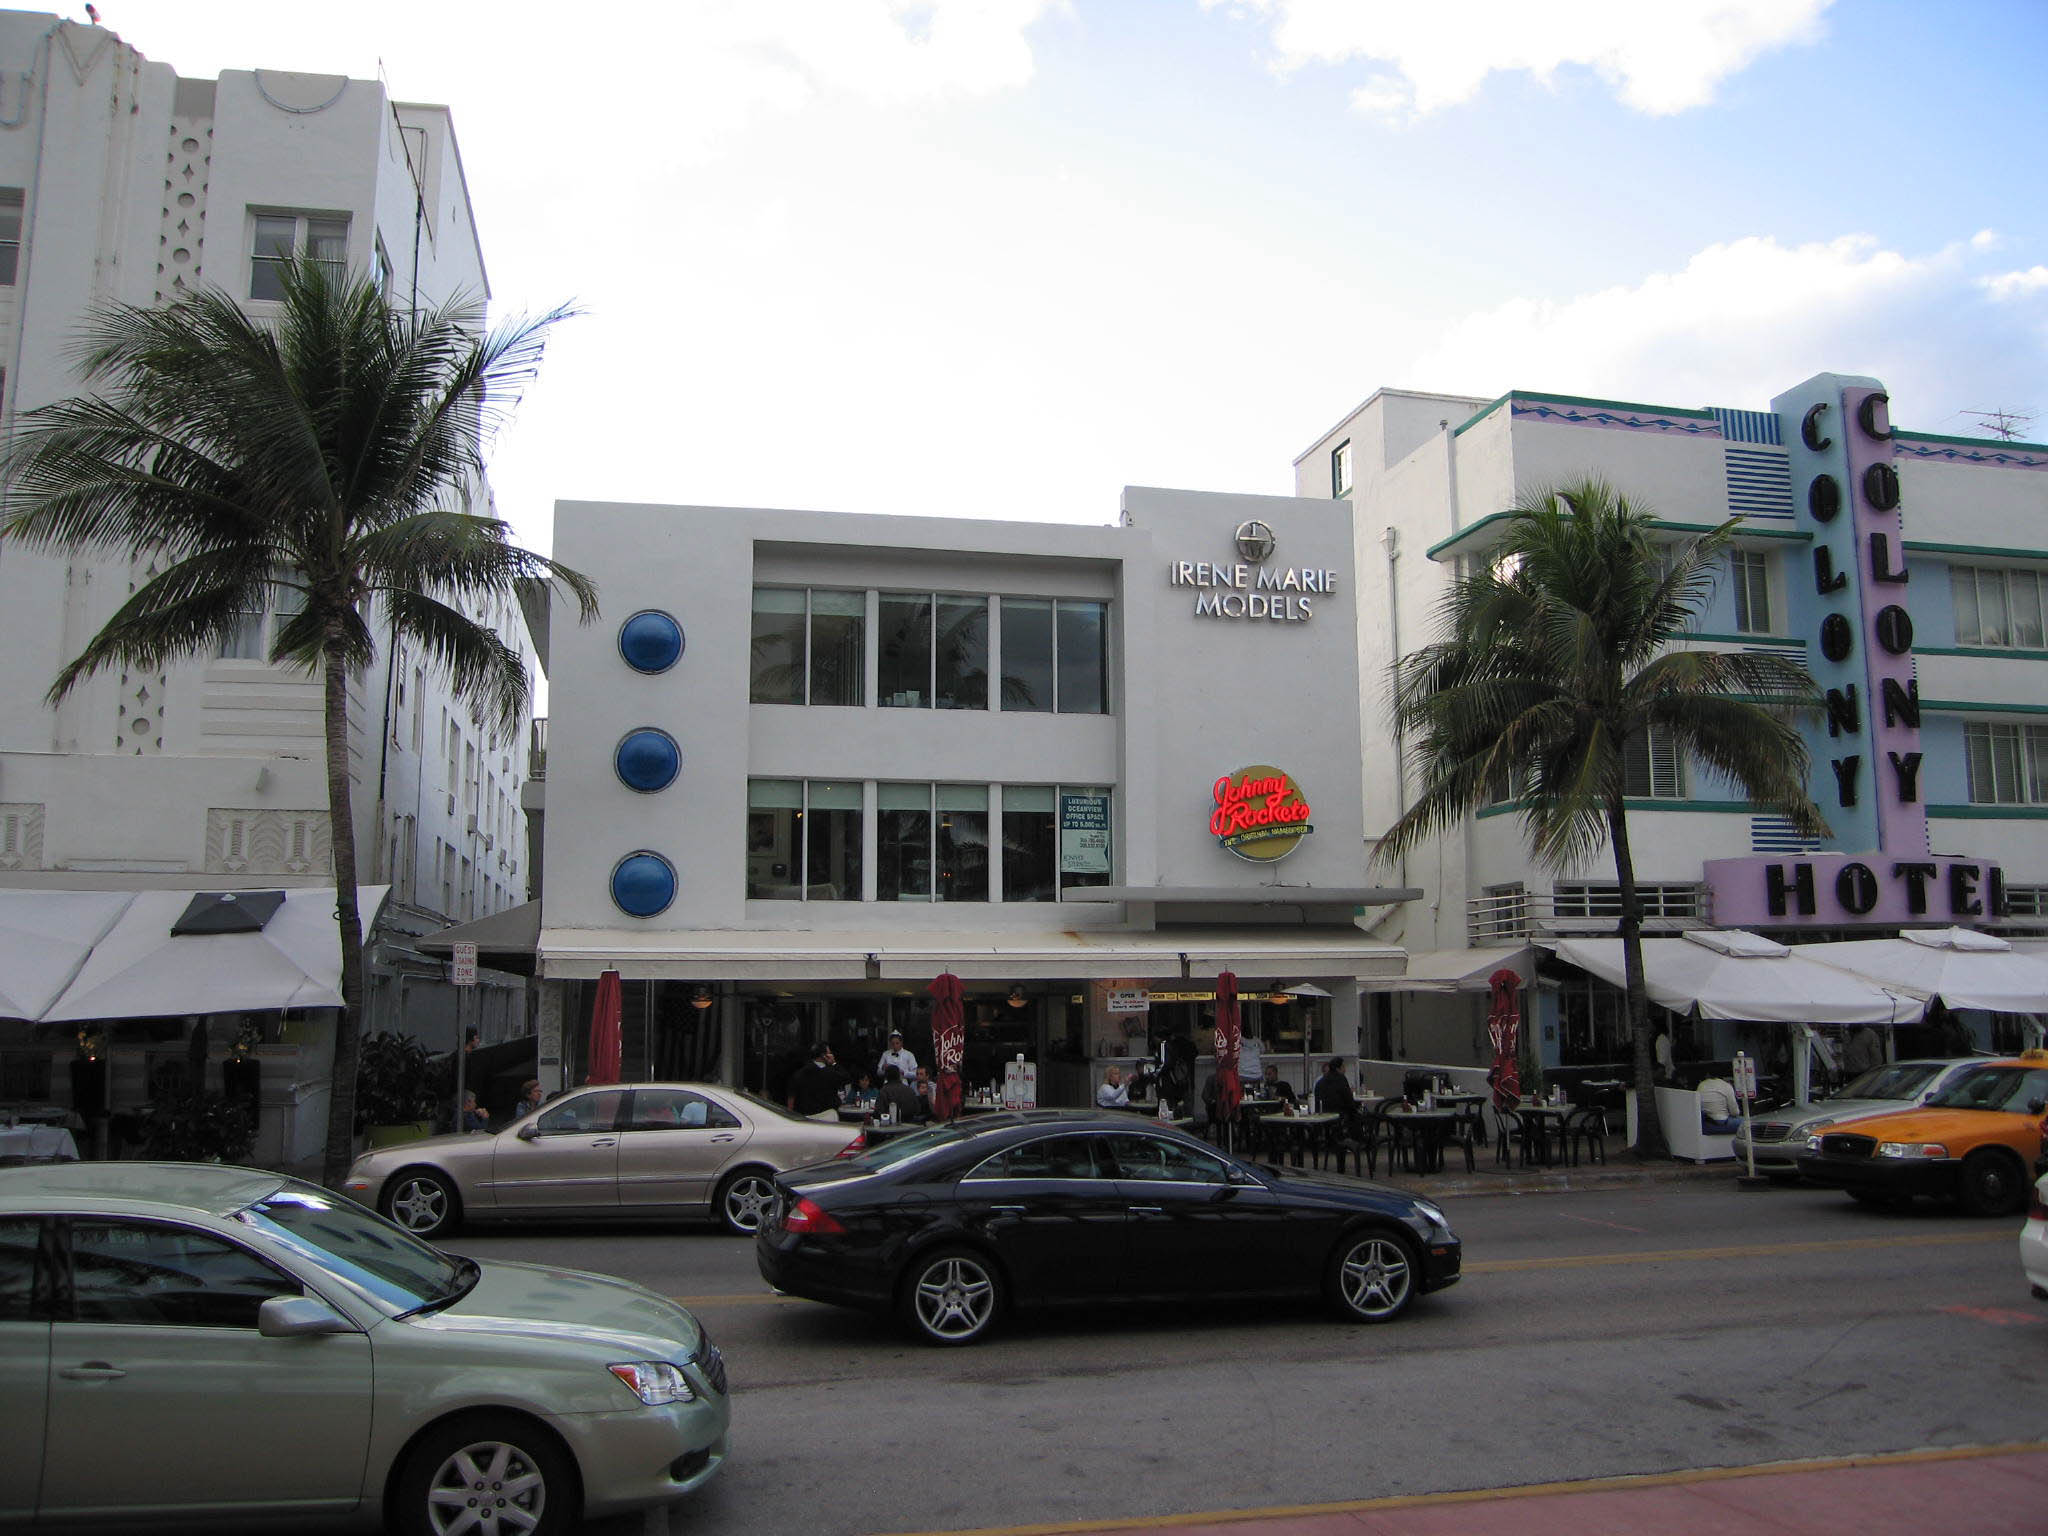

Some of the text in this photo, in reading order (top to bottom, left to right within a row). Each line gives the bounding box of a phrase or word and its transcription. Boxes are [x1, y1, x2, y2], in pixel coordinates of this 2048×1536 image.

[1170, 560, 1337, 593] IRENE MARIE
[1194, 592, 1313, 622] MODELS
[1801, 403, 1860, 808] COLONY
[1857, 393, 1924, 802] COLONY
[1211, 774, 1294, 834] Johnny
[1218, 799, 1310, 836] Rockets
[1765, 862, 2010, 917] HOTEL
[455, 945, 475, 954] GUEST
[457, 967, 472, 976] ZONE
[1007, 1073, 1034, 1081] PAING
